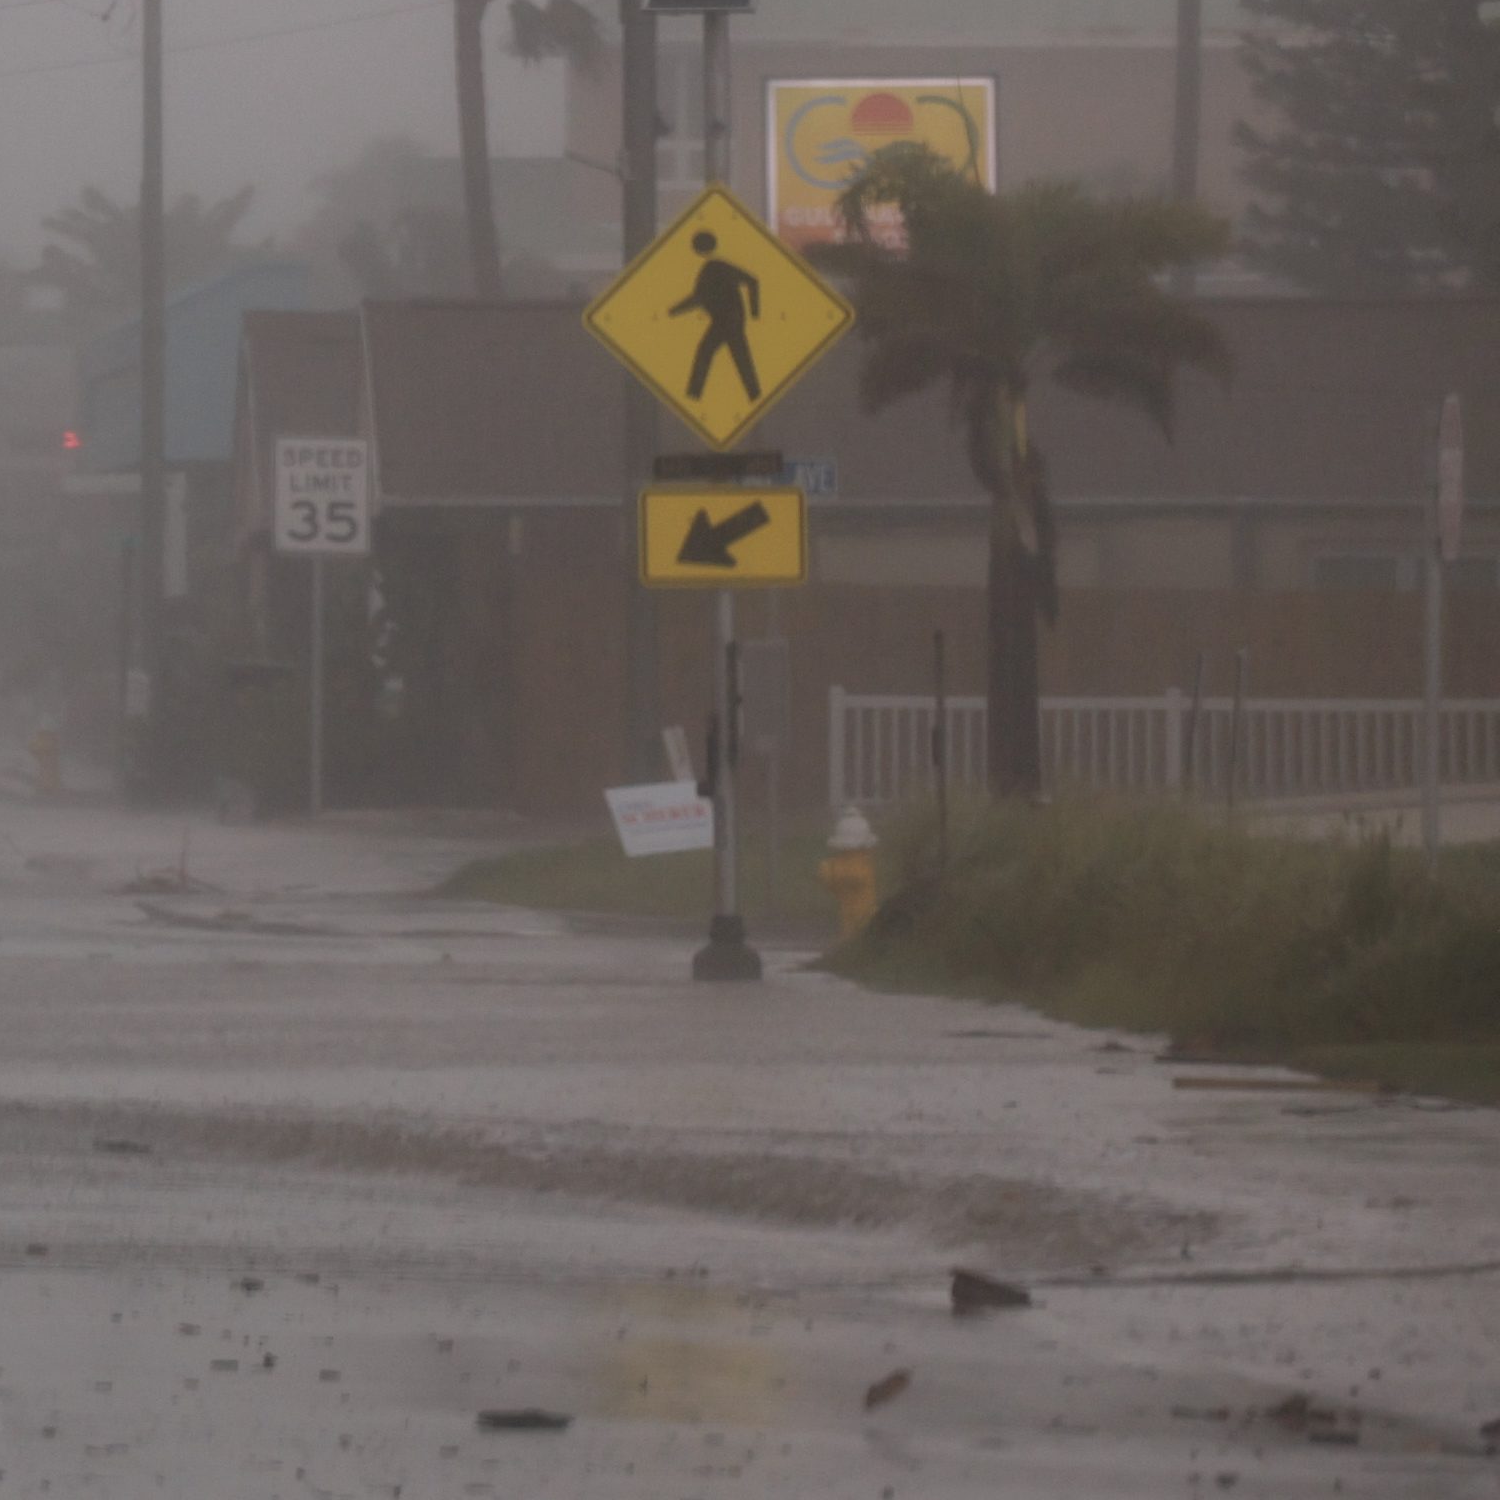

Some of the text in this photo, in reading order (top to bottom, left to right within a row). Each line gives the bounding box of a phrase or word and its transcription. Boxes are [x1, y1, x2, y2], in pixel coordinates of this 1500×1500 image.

[283, 447, 363, 469] SPEED
[289, 472, 353, 493] LIMIT
[287, 499, 358, 541] 35
